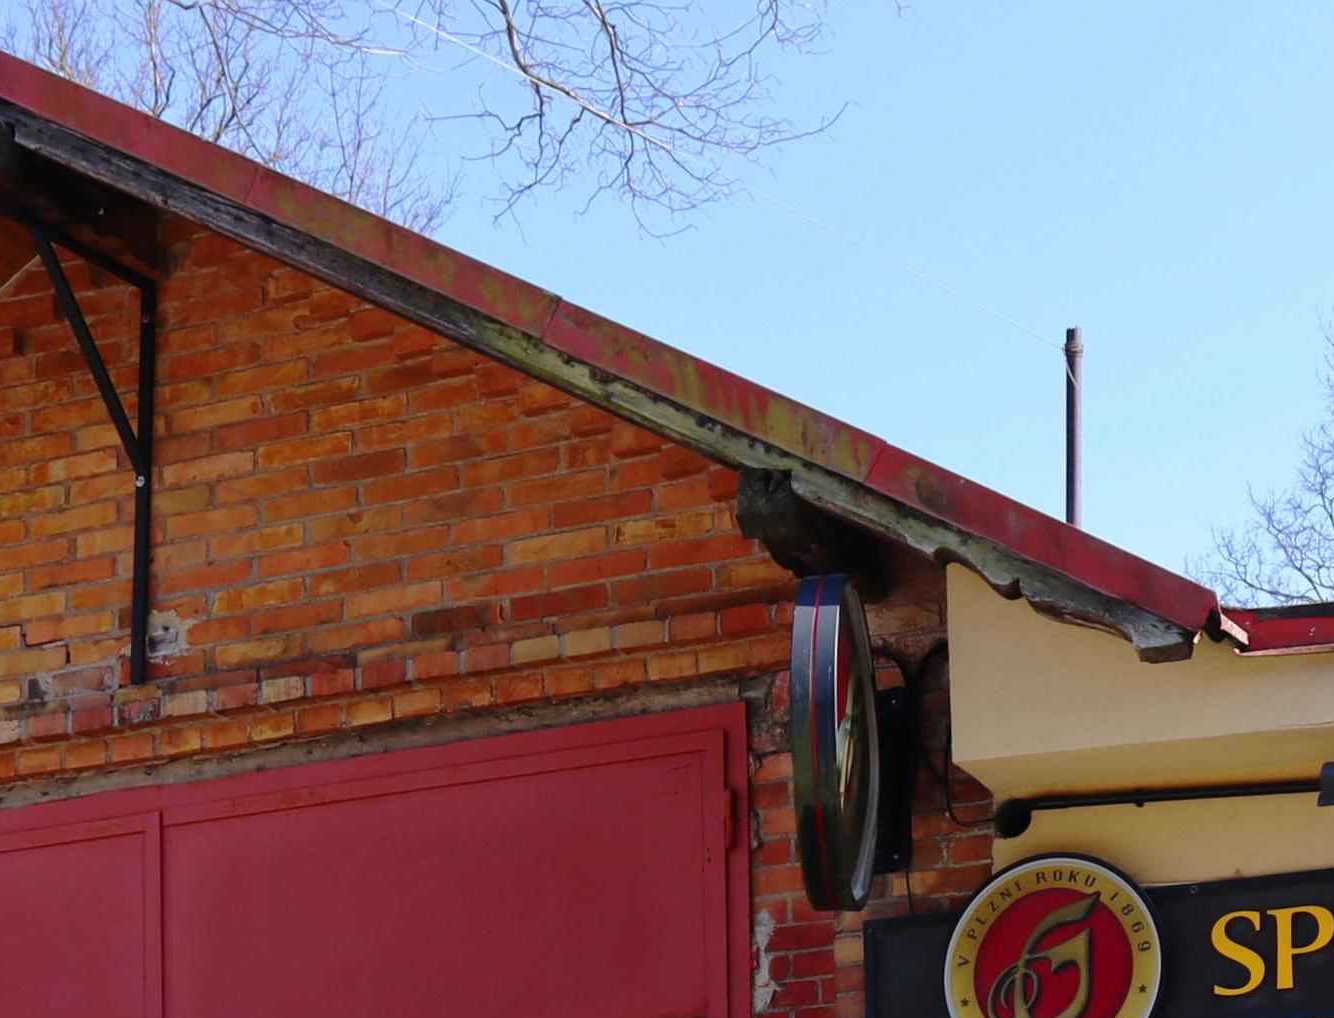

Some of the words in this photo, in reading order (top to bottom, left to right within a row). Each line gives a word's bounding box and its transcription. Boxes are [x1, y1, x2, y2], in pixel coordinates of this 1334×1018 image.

[957, 955, 970, 968] V
[967, 881, 1024, 941] PLZNI
[1035, 869, 1097, 888] ROKU
[1110, 891, 1152, 952] 1869
